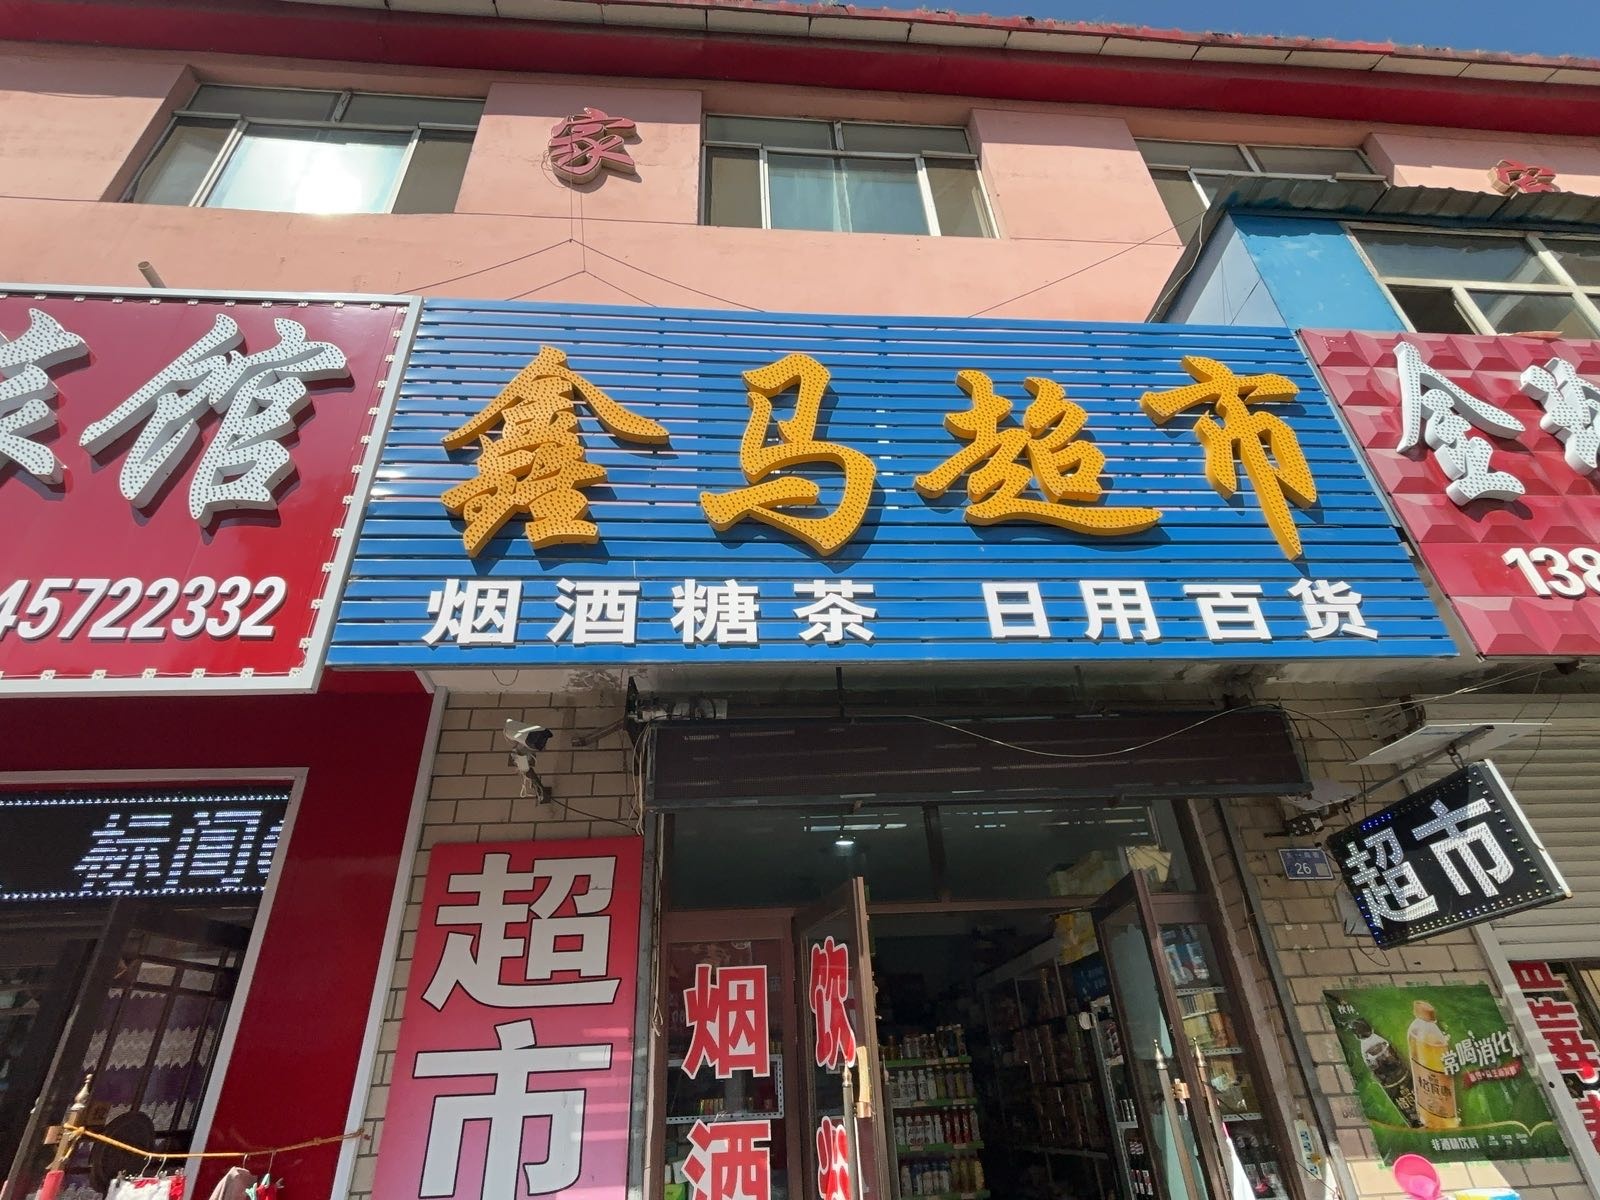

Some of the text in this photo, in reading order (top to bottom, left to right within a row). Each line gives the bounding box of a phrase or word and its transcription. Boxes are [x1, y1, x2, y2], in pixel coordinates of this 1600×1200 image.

[441, 345, 1319, 561] 鑫马超市
[423, 577, 878, 648] 烟酒糖茶
[981, 578, 1380, 643] 日用百货
[1294, 862, 1312, 875] 26
[1345, 799, 1515, 930] 超市
[413, 852, 622, 1200] 超市
[681, 963, 772, 1200] 烟酒
